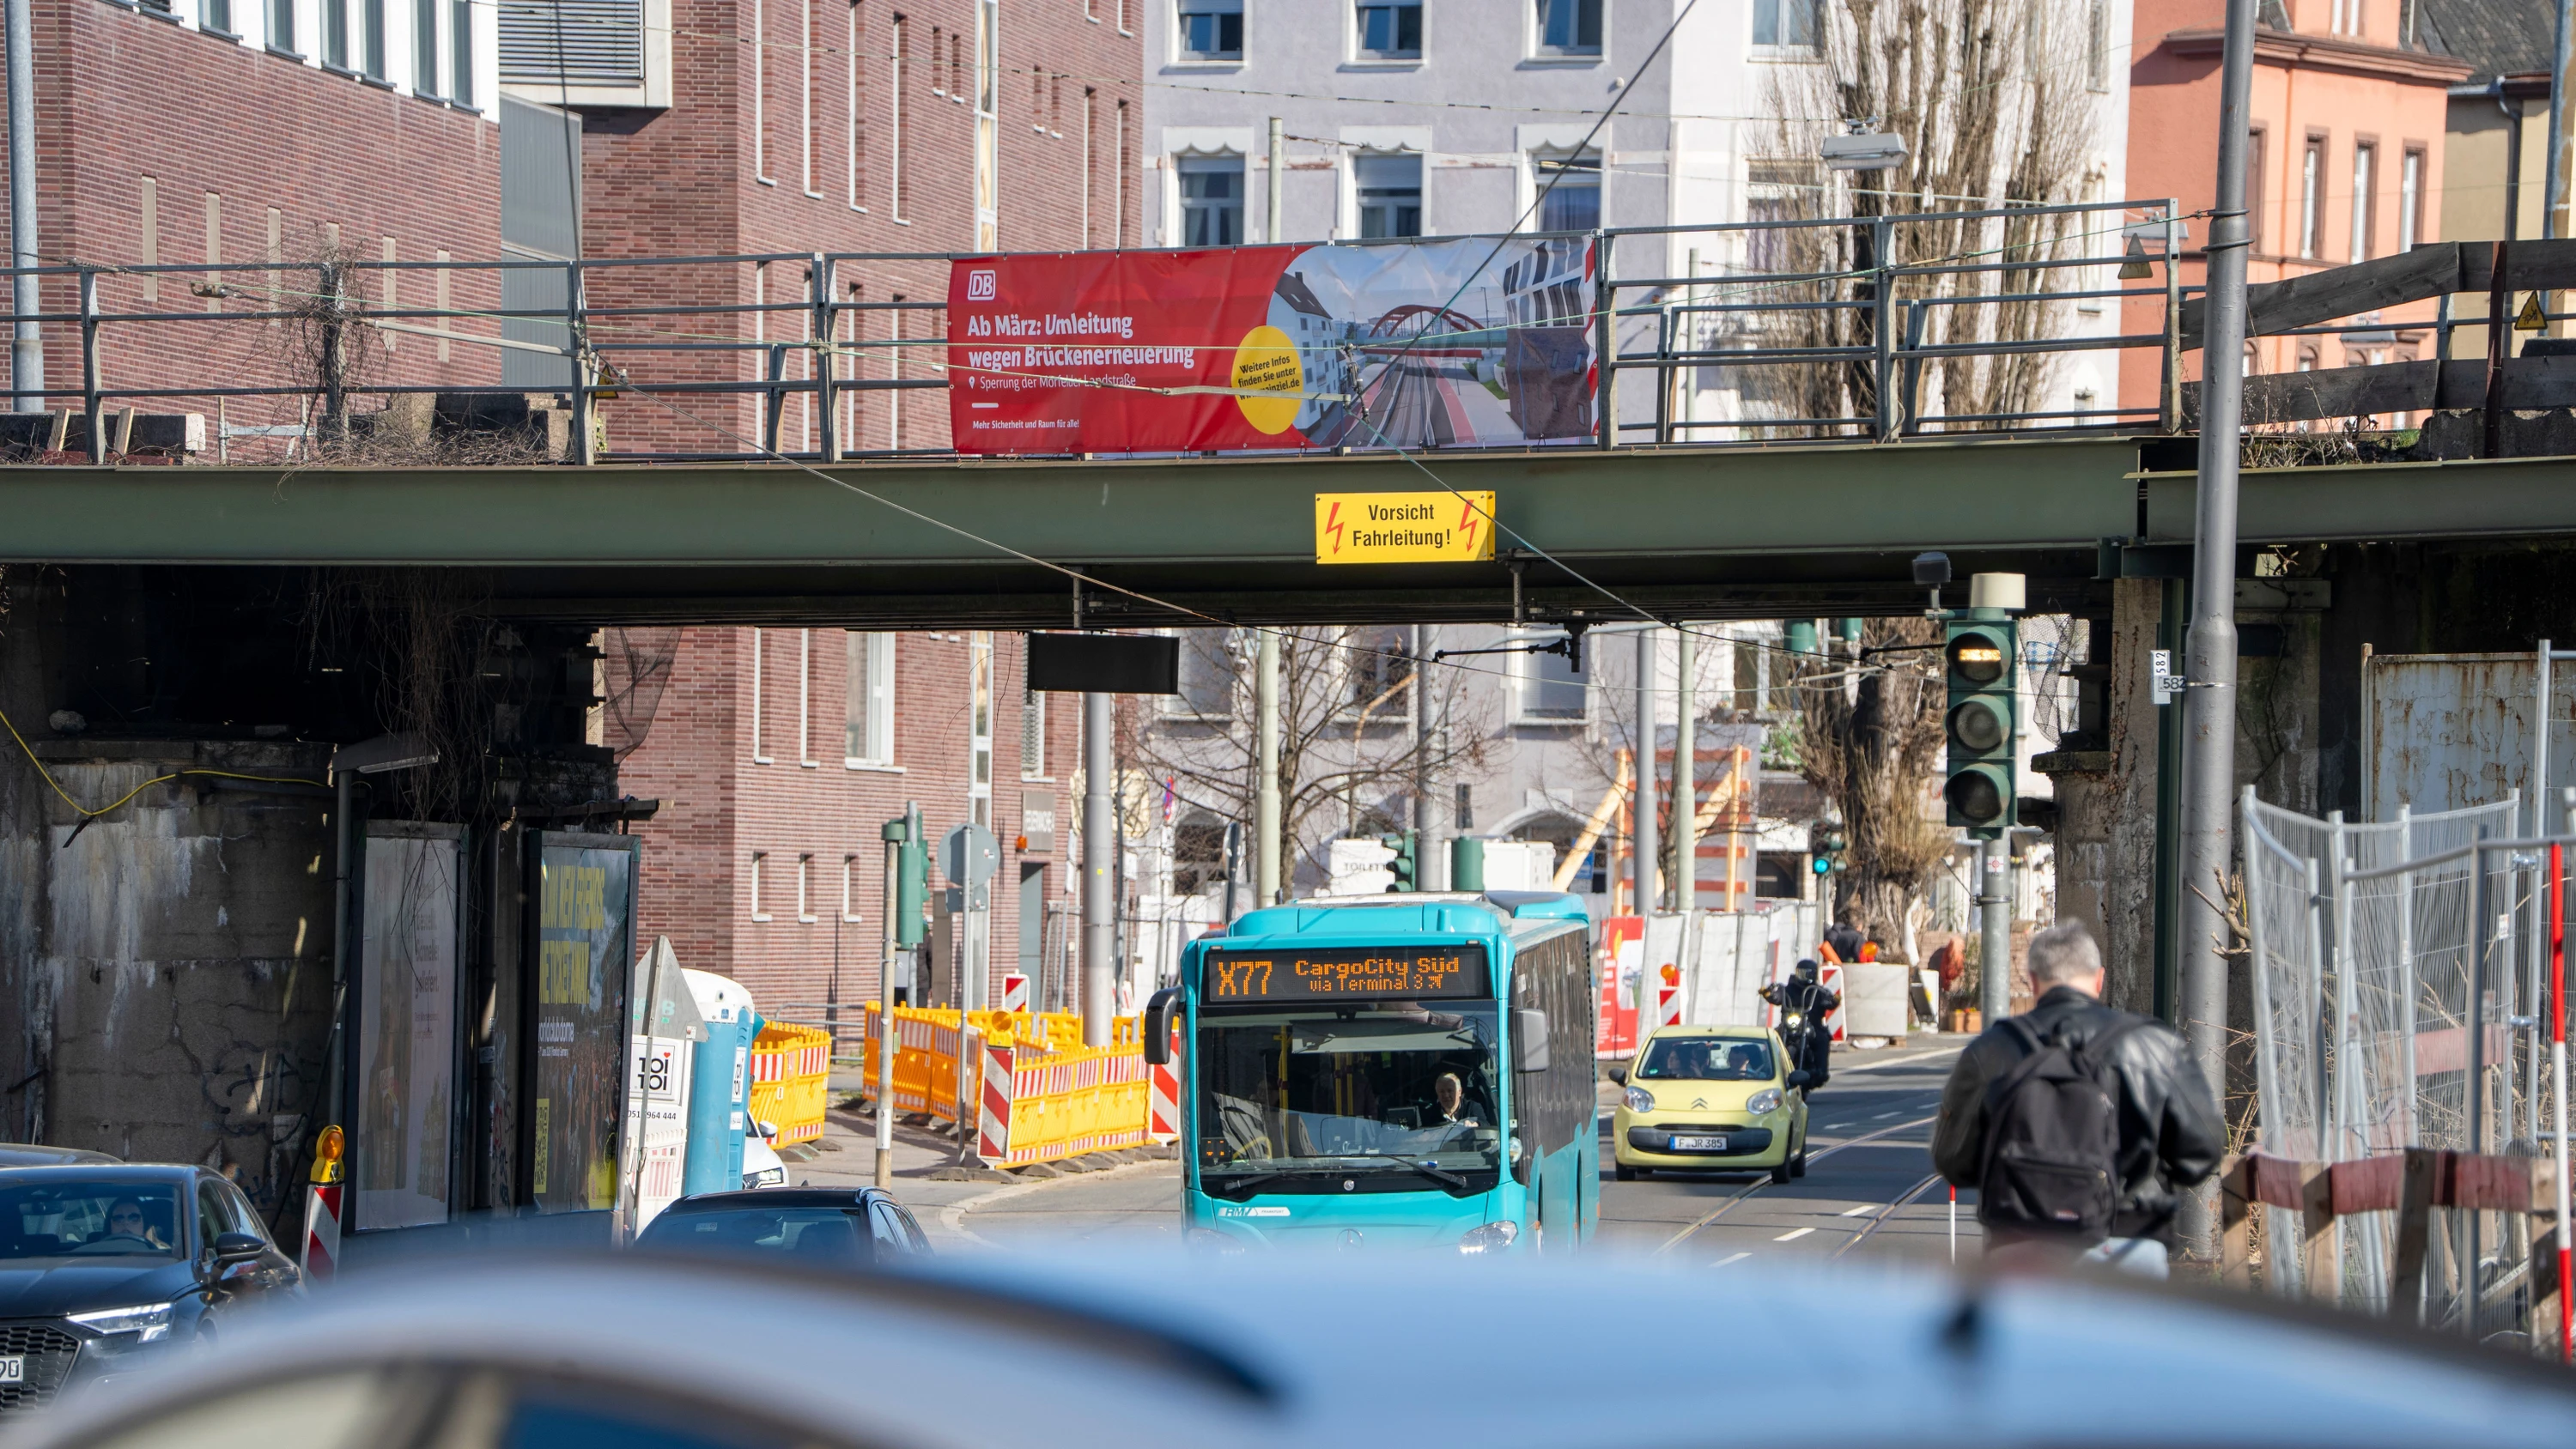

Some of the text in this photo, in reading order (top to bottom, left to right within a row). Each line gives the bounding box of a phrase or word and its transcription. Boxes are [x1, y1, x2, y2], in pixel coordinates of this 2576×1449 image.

[971, 275, 993, 297] DB
[968, 312, 1133, 339] Ab März: Umleitung
[969, 345, 1194, 372] wegen Brückenerneuerung
[1239, 355, 1291, 374] Weitere Infos
[980, 376, 1020, 392] Sperrung
[1022, 376, 1036, 388] der
[1237, 367, 1297, 388] finden Sie unter
[973, 419, 1079, 429] Mehr Sicherheit und Raum für alle!
[1368, 504, 1435, 521] Vorsicht
[2156, 652, 2166, 673] 582
[2164, 677, 2186, 690] 582
[1344, 862, 1387, 872] TOILETT
[1218, 957, 1460, 996] X77 CargoCity Süd
[1309, 974, 1423, 991] via Terminal 3
[639, 1057, 669, 1075] TOI
[637, 1074, 667, 1091] TOI
[647, 1111, 661, 1119] 964
[1705, 1139, 1722, 1149] 385
